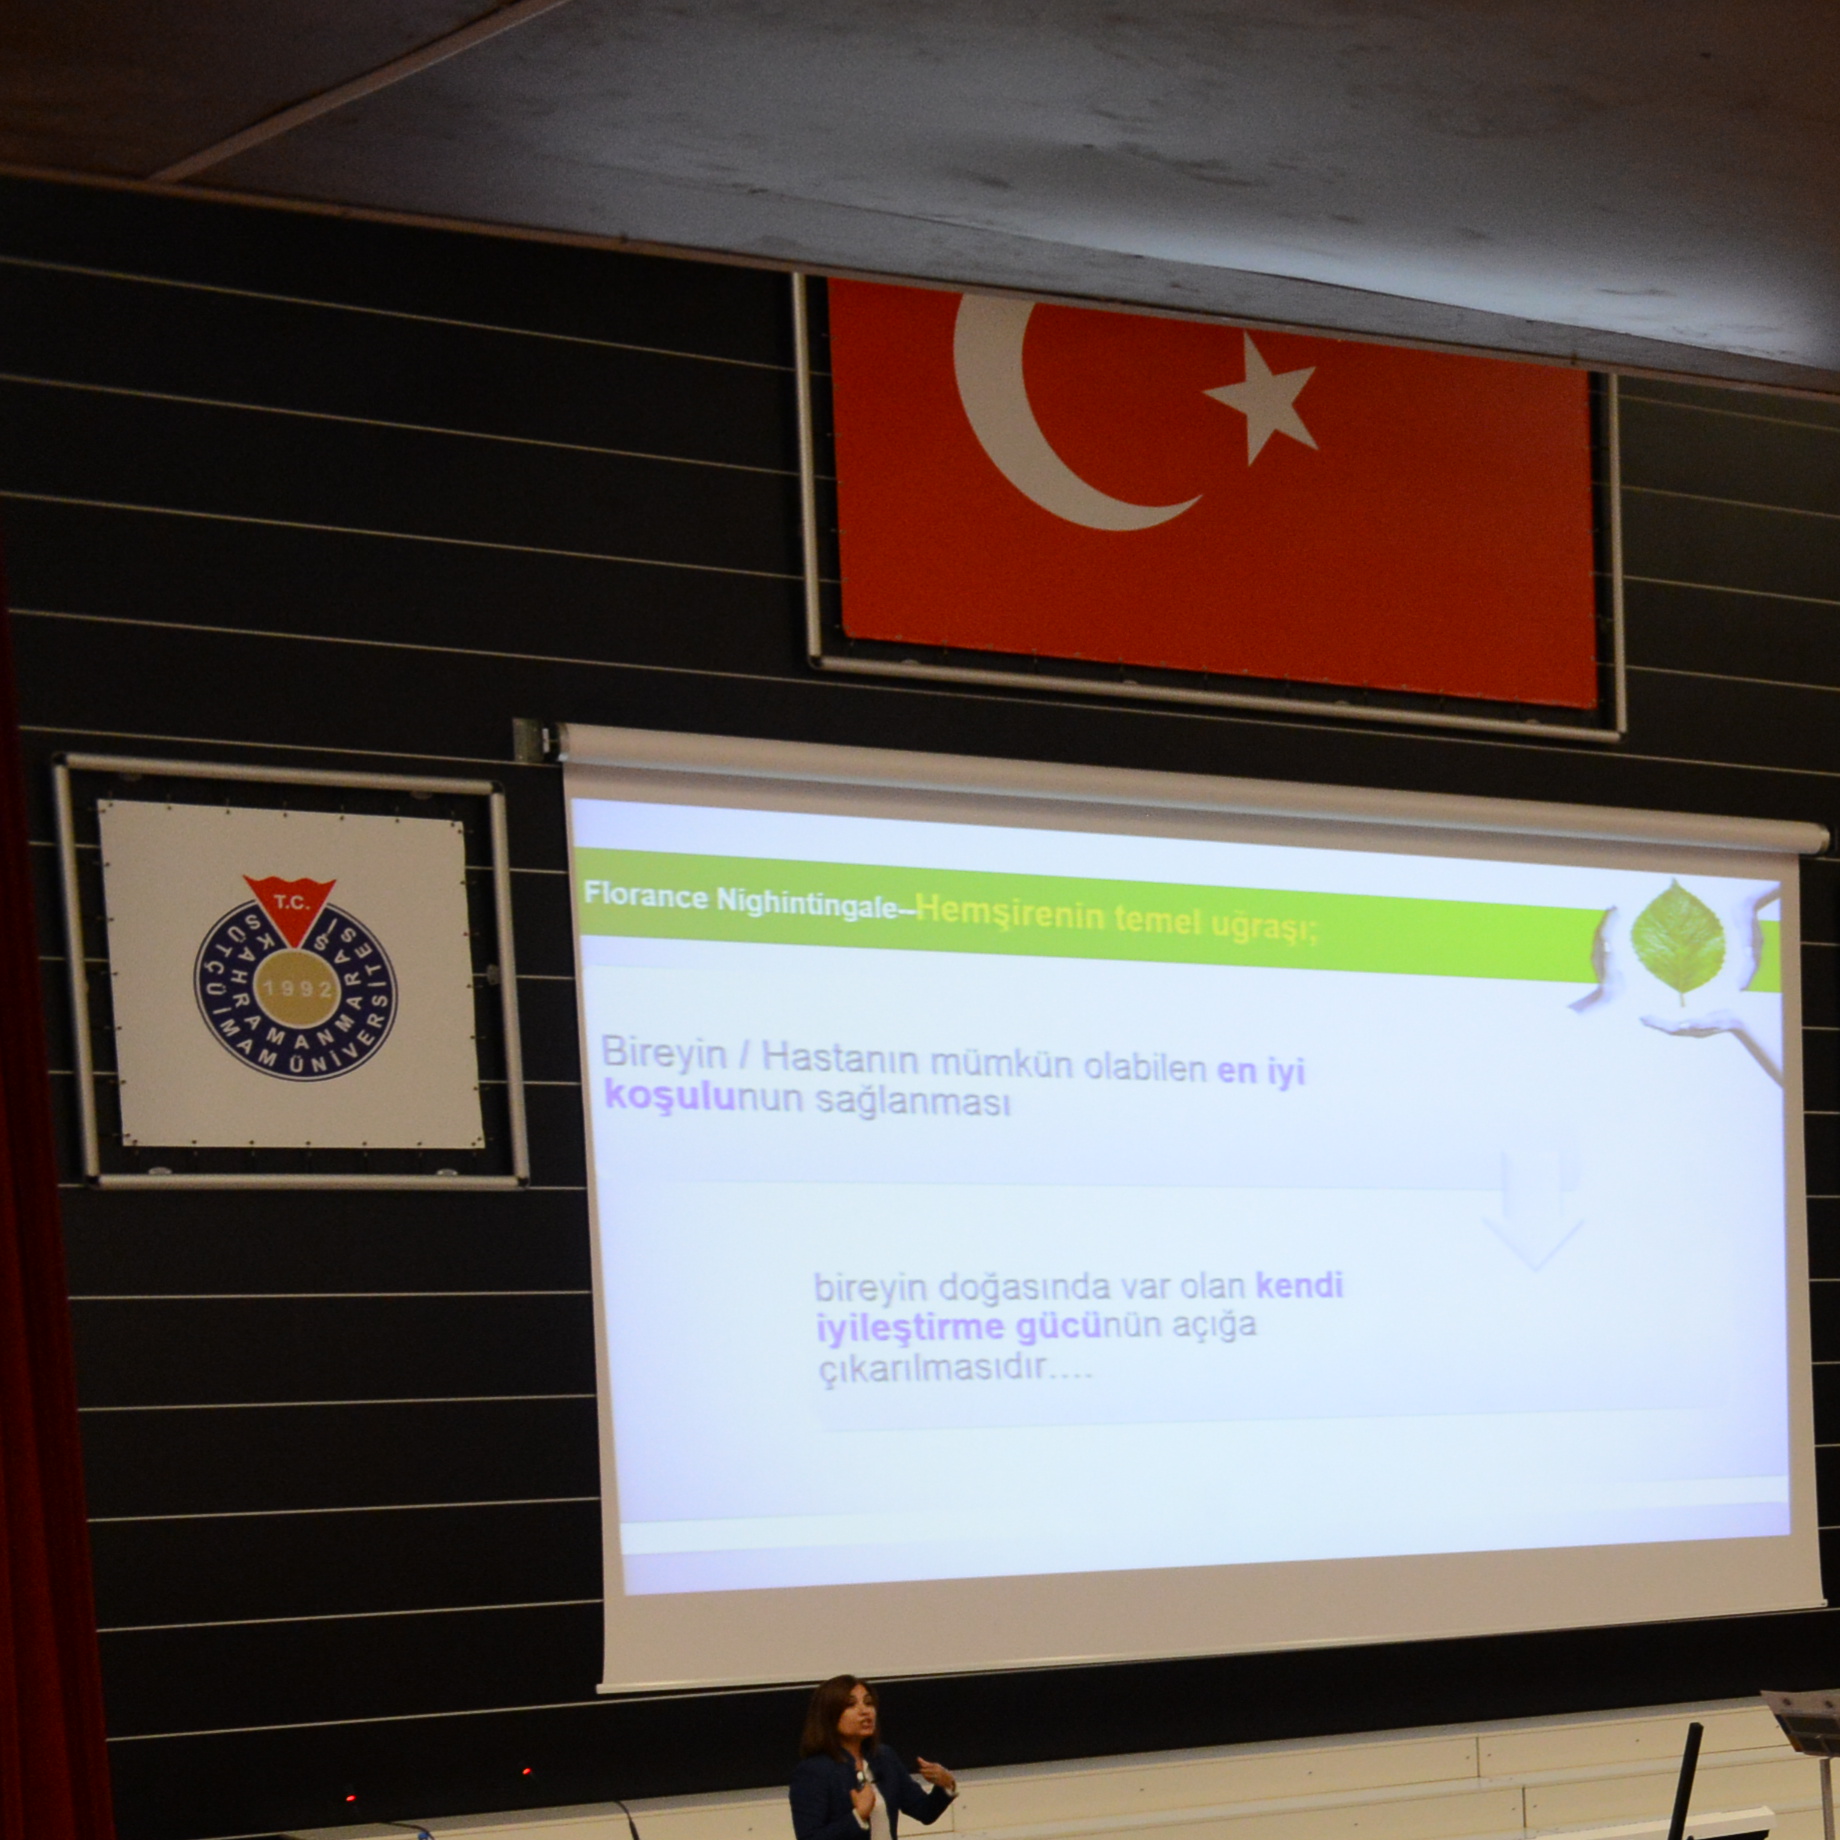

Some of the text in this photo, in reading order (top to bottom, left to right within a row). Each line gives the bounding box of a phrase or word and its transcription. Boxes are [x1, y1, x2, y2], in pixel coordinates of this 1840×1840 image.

[273, 895, 310, 910] T.C.
[584, 879, 709, 909] Florance
[1114, 904, 1201, 935] temel
[1212, 910, 1318, 946] uğraşı;
[204, 914, 261, 996] SÜTÇÜ
[230, 932, 363, 1049] KAHRAMANMARAŞ
[263, 980, 333, 998] 1992
[602, 1034, 1306, 1091] Bireyin / Hastanın mümkün olabilen en iyi
[604, 1077, 1011, 1120] koşulunun sağlanması
[814, 1270, 1344, 1309] bireyin doğasında var olan kendi
[816, 1309, 1258, 1349] iyileştirme gücünün açığa
